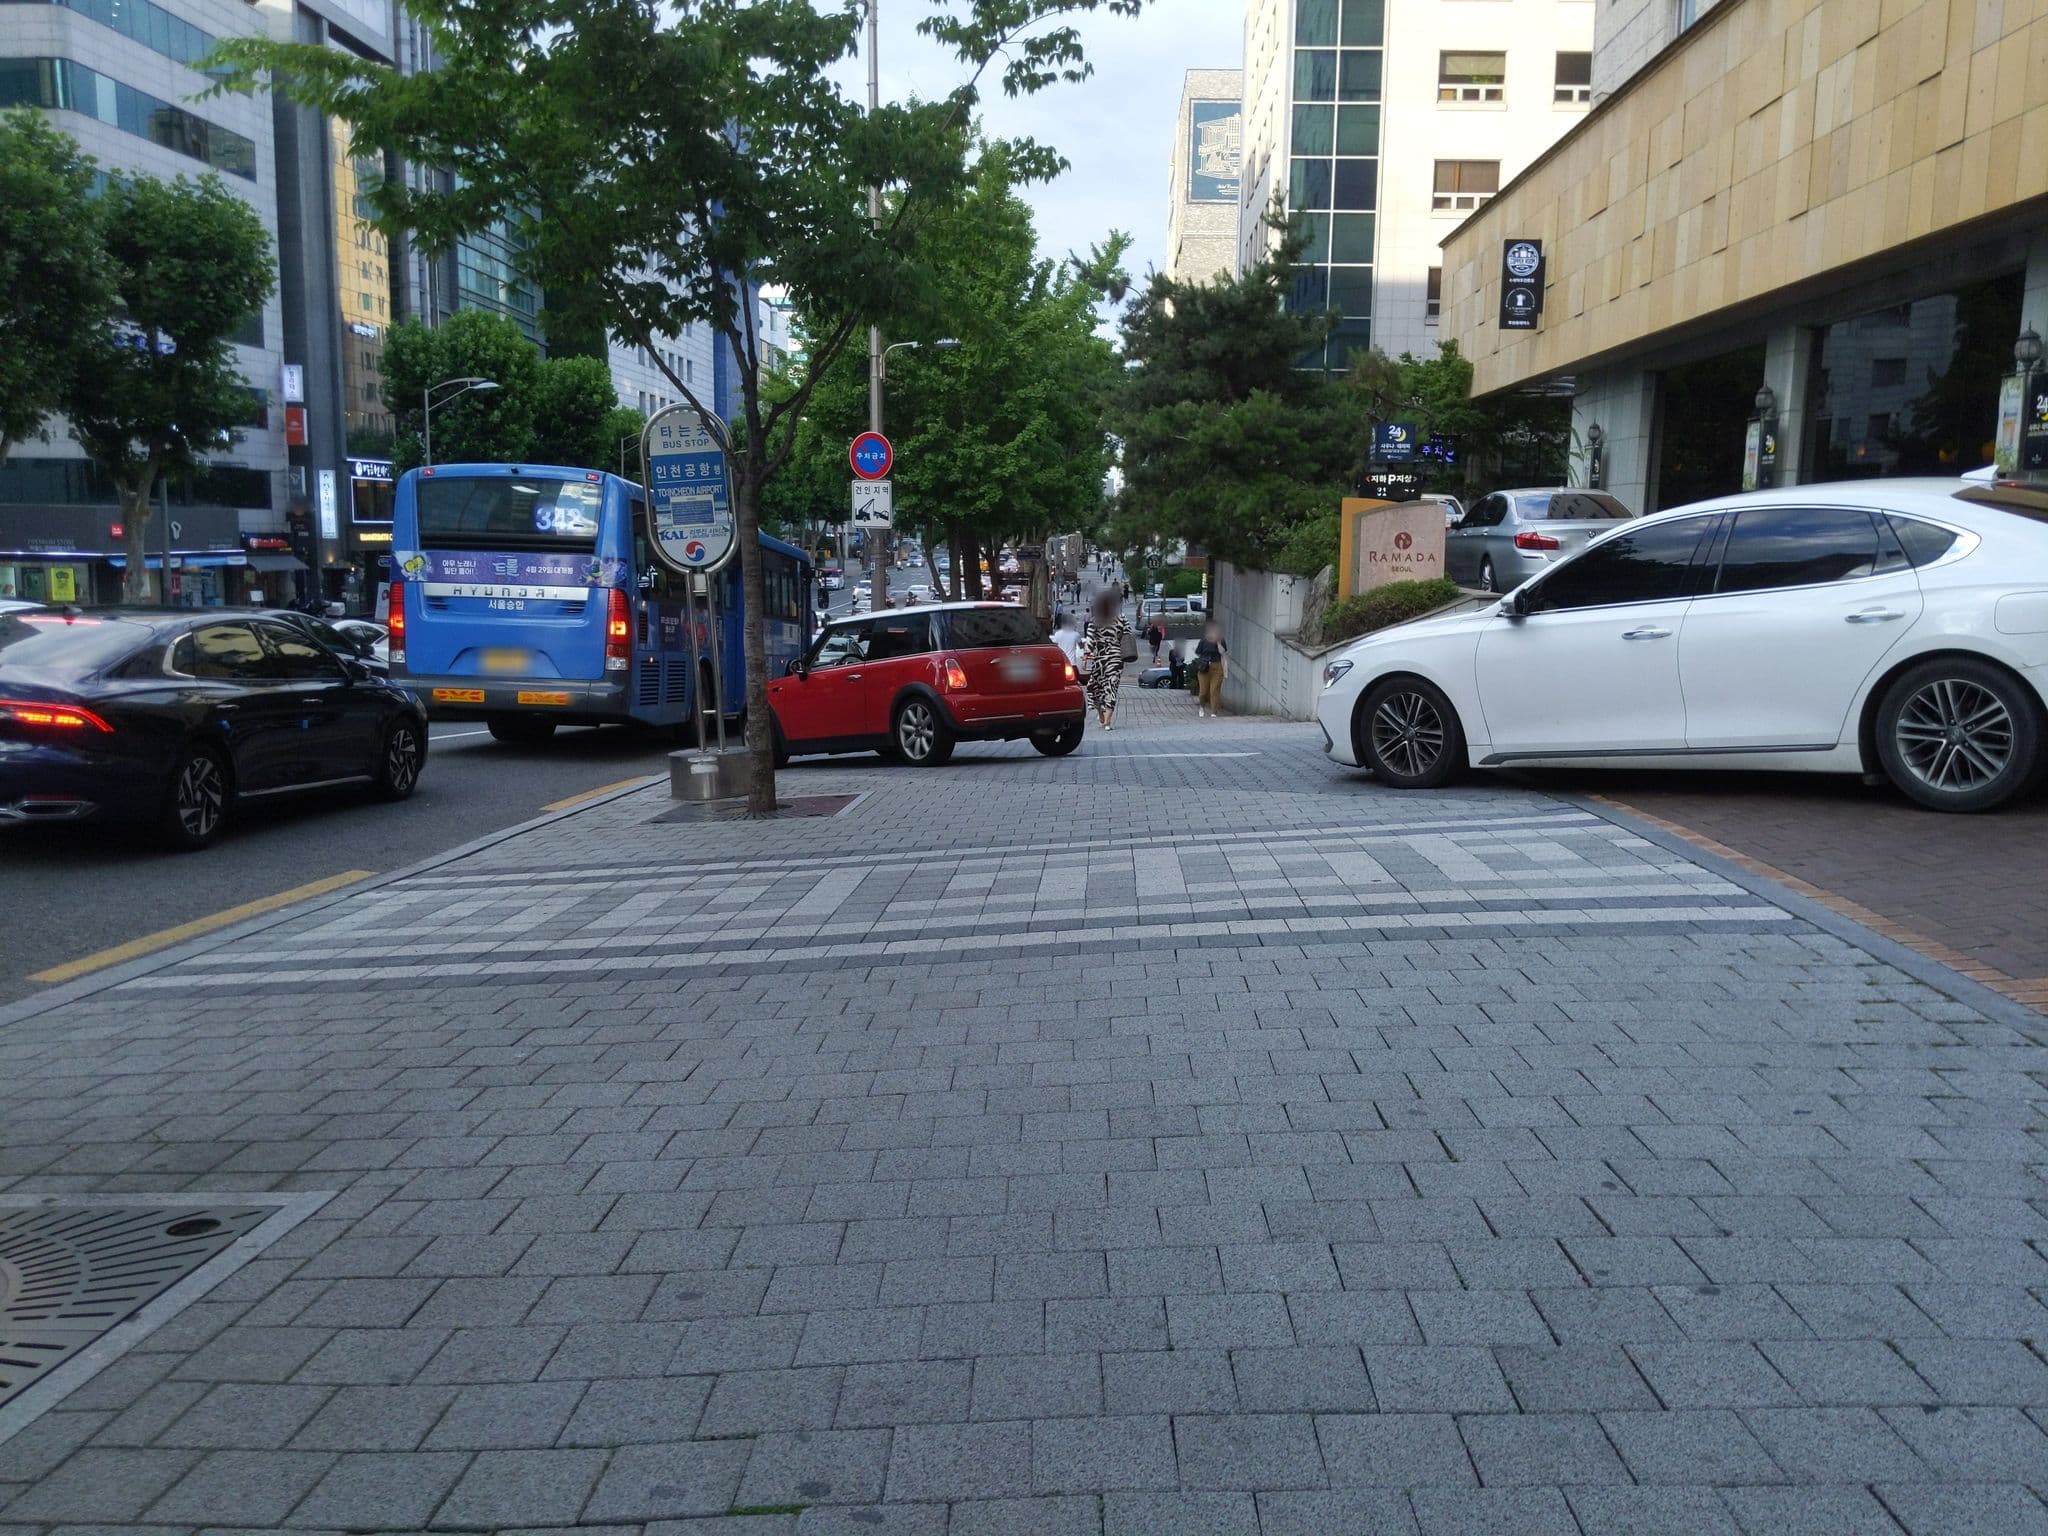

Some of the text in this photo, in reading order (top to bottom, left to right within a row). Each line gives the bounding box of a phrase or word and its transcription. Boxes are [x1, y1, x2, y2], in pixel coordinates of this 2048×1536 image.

[662, 438, 709, 449] BUS STOP
[856, 452, 886, 460] 주차금지
[1371, 474, 1387, 483] 지하
[1396, 474, 1413, 483] 지상
[696, 484, 723, 495] AIRPORT
[855, 485, 889, 495] 견인지역
[660, 530, 689, 541] KAL
[1369, 551, 1436, 562] RAMADA
[456, 559, 477, 567] 노래나
[444, 567, 457, 575] 일단
[525, 565, 537, 574] 4월
[453, 586, 558, 598] HYUNDAI
[488, 600, 524, 610] 서울승합
